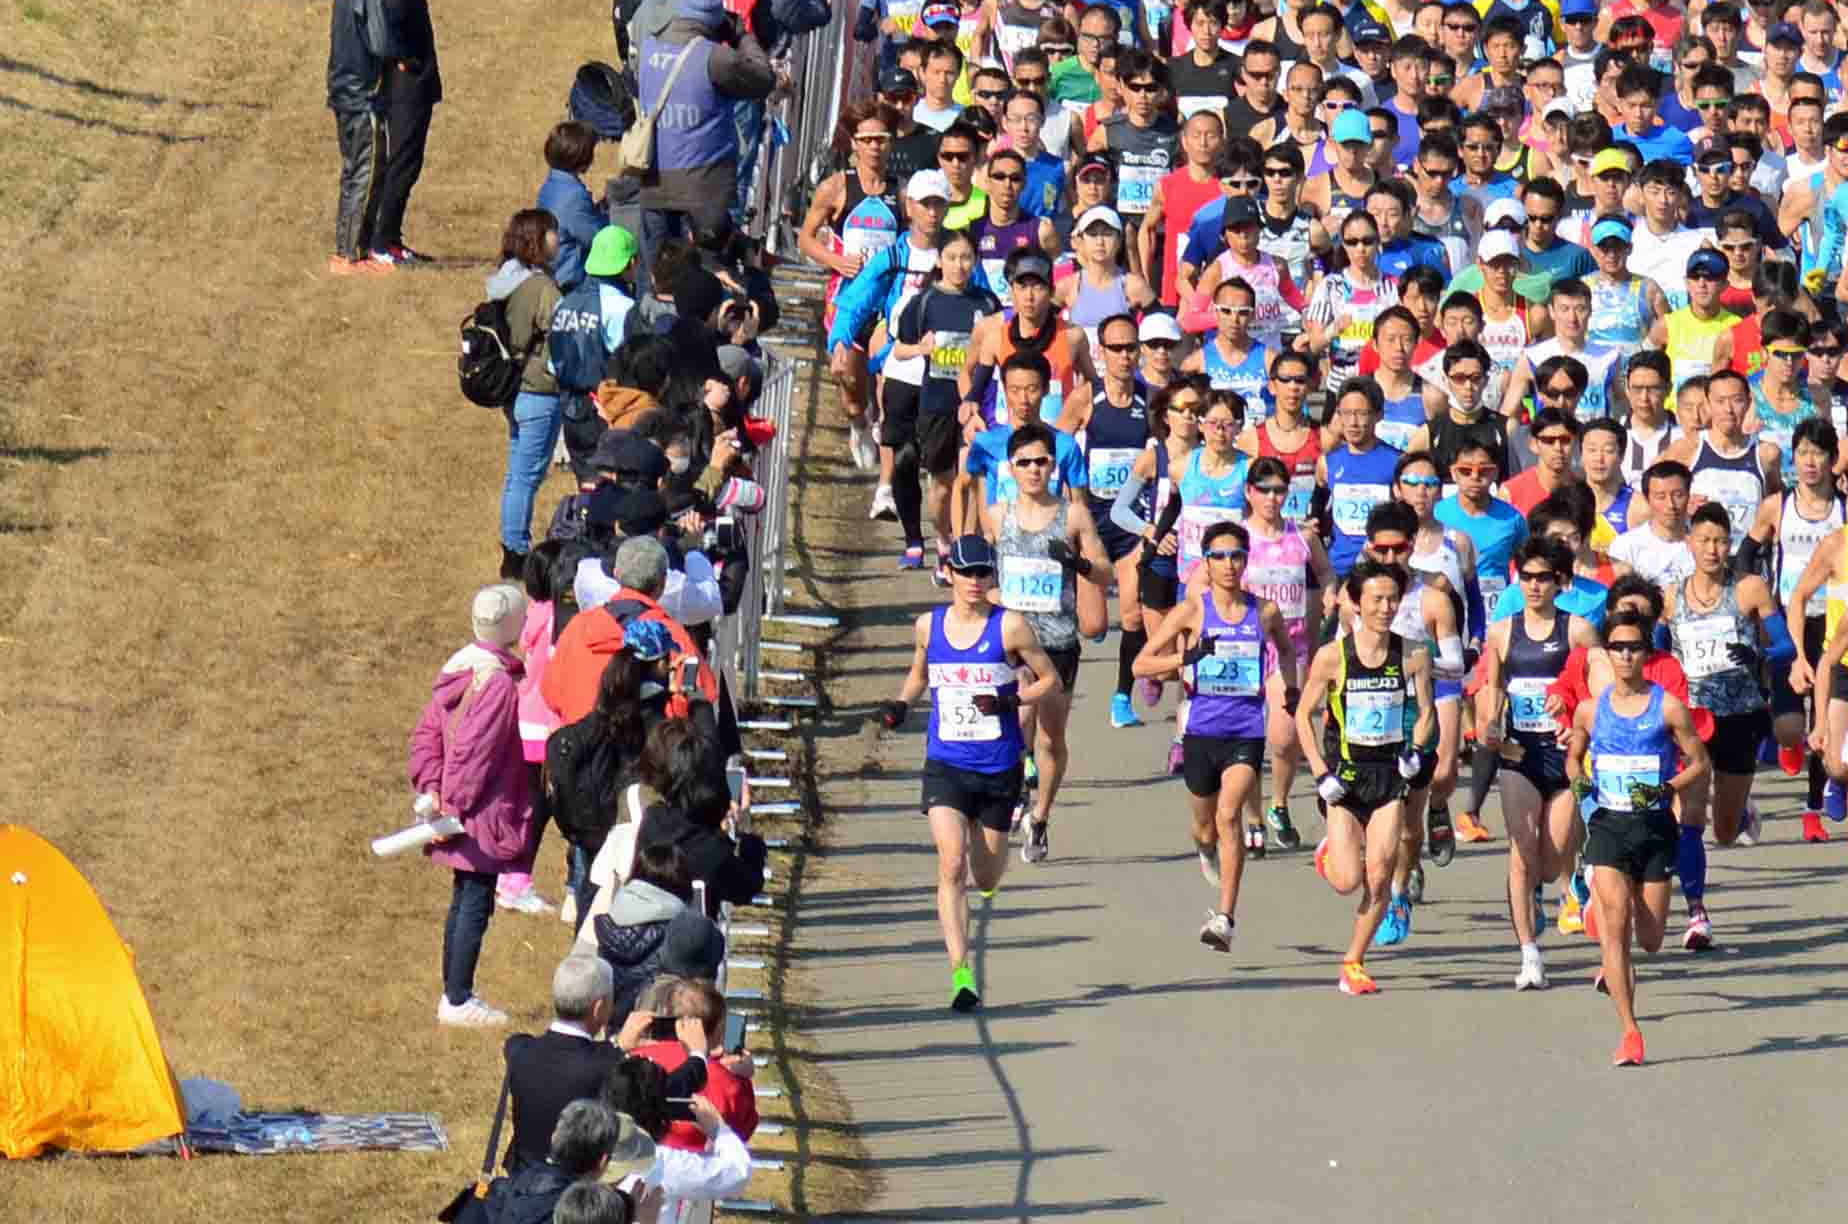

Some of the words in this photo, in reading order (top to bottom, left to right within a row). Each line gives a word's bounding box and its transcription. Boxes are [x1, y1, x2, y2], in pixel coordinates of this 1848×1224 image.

[551, 309, 600, 334] STAFF
[1019, 576, 1055, 596] 126
[1217, 661, 1240, 681] 23
[954, 706, 978, 725] 52
[1372, 711, 1383, 730] 2
